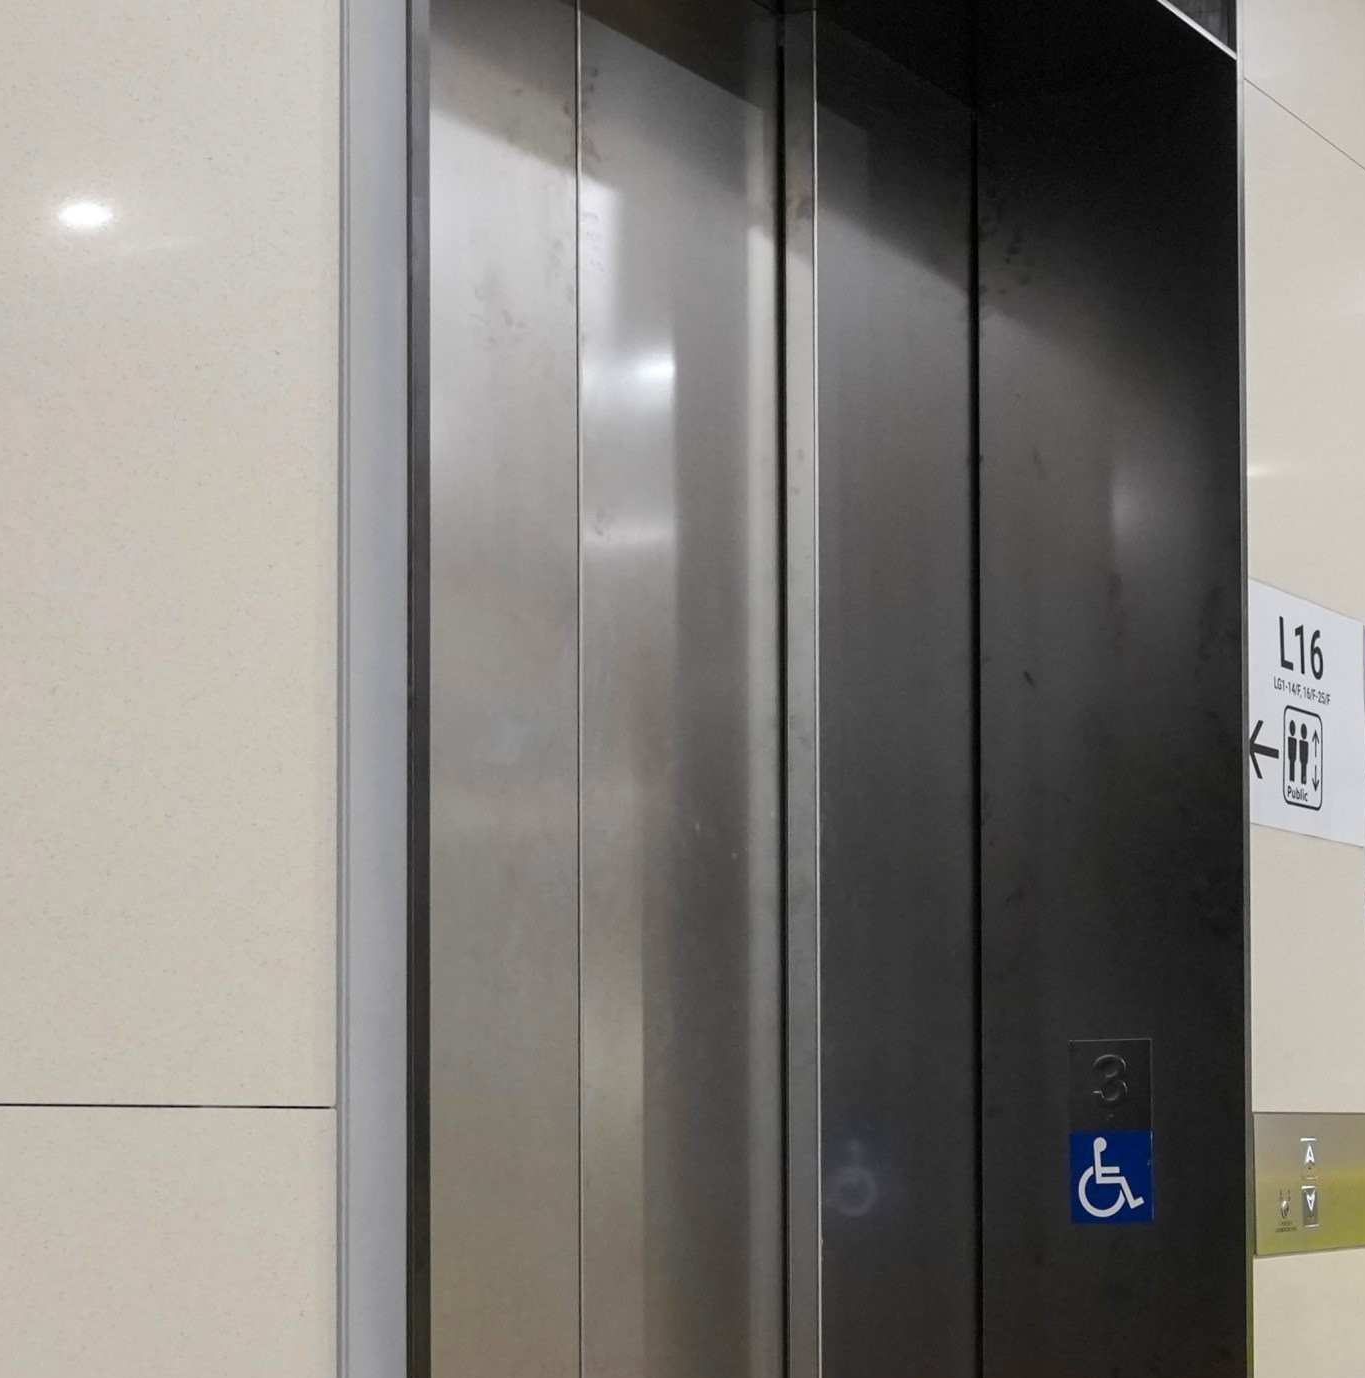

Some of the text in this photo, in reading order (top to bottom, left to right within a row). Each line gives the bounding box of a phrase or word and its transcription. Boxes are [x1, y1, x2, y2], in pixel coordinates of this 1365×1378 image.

[1279, 616, 1324, 680] L16
[1287, 786, 1308, 802] Public
[1094, 1054, 1128, 1103] 3
